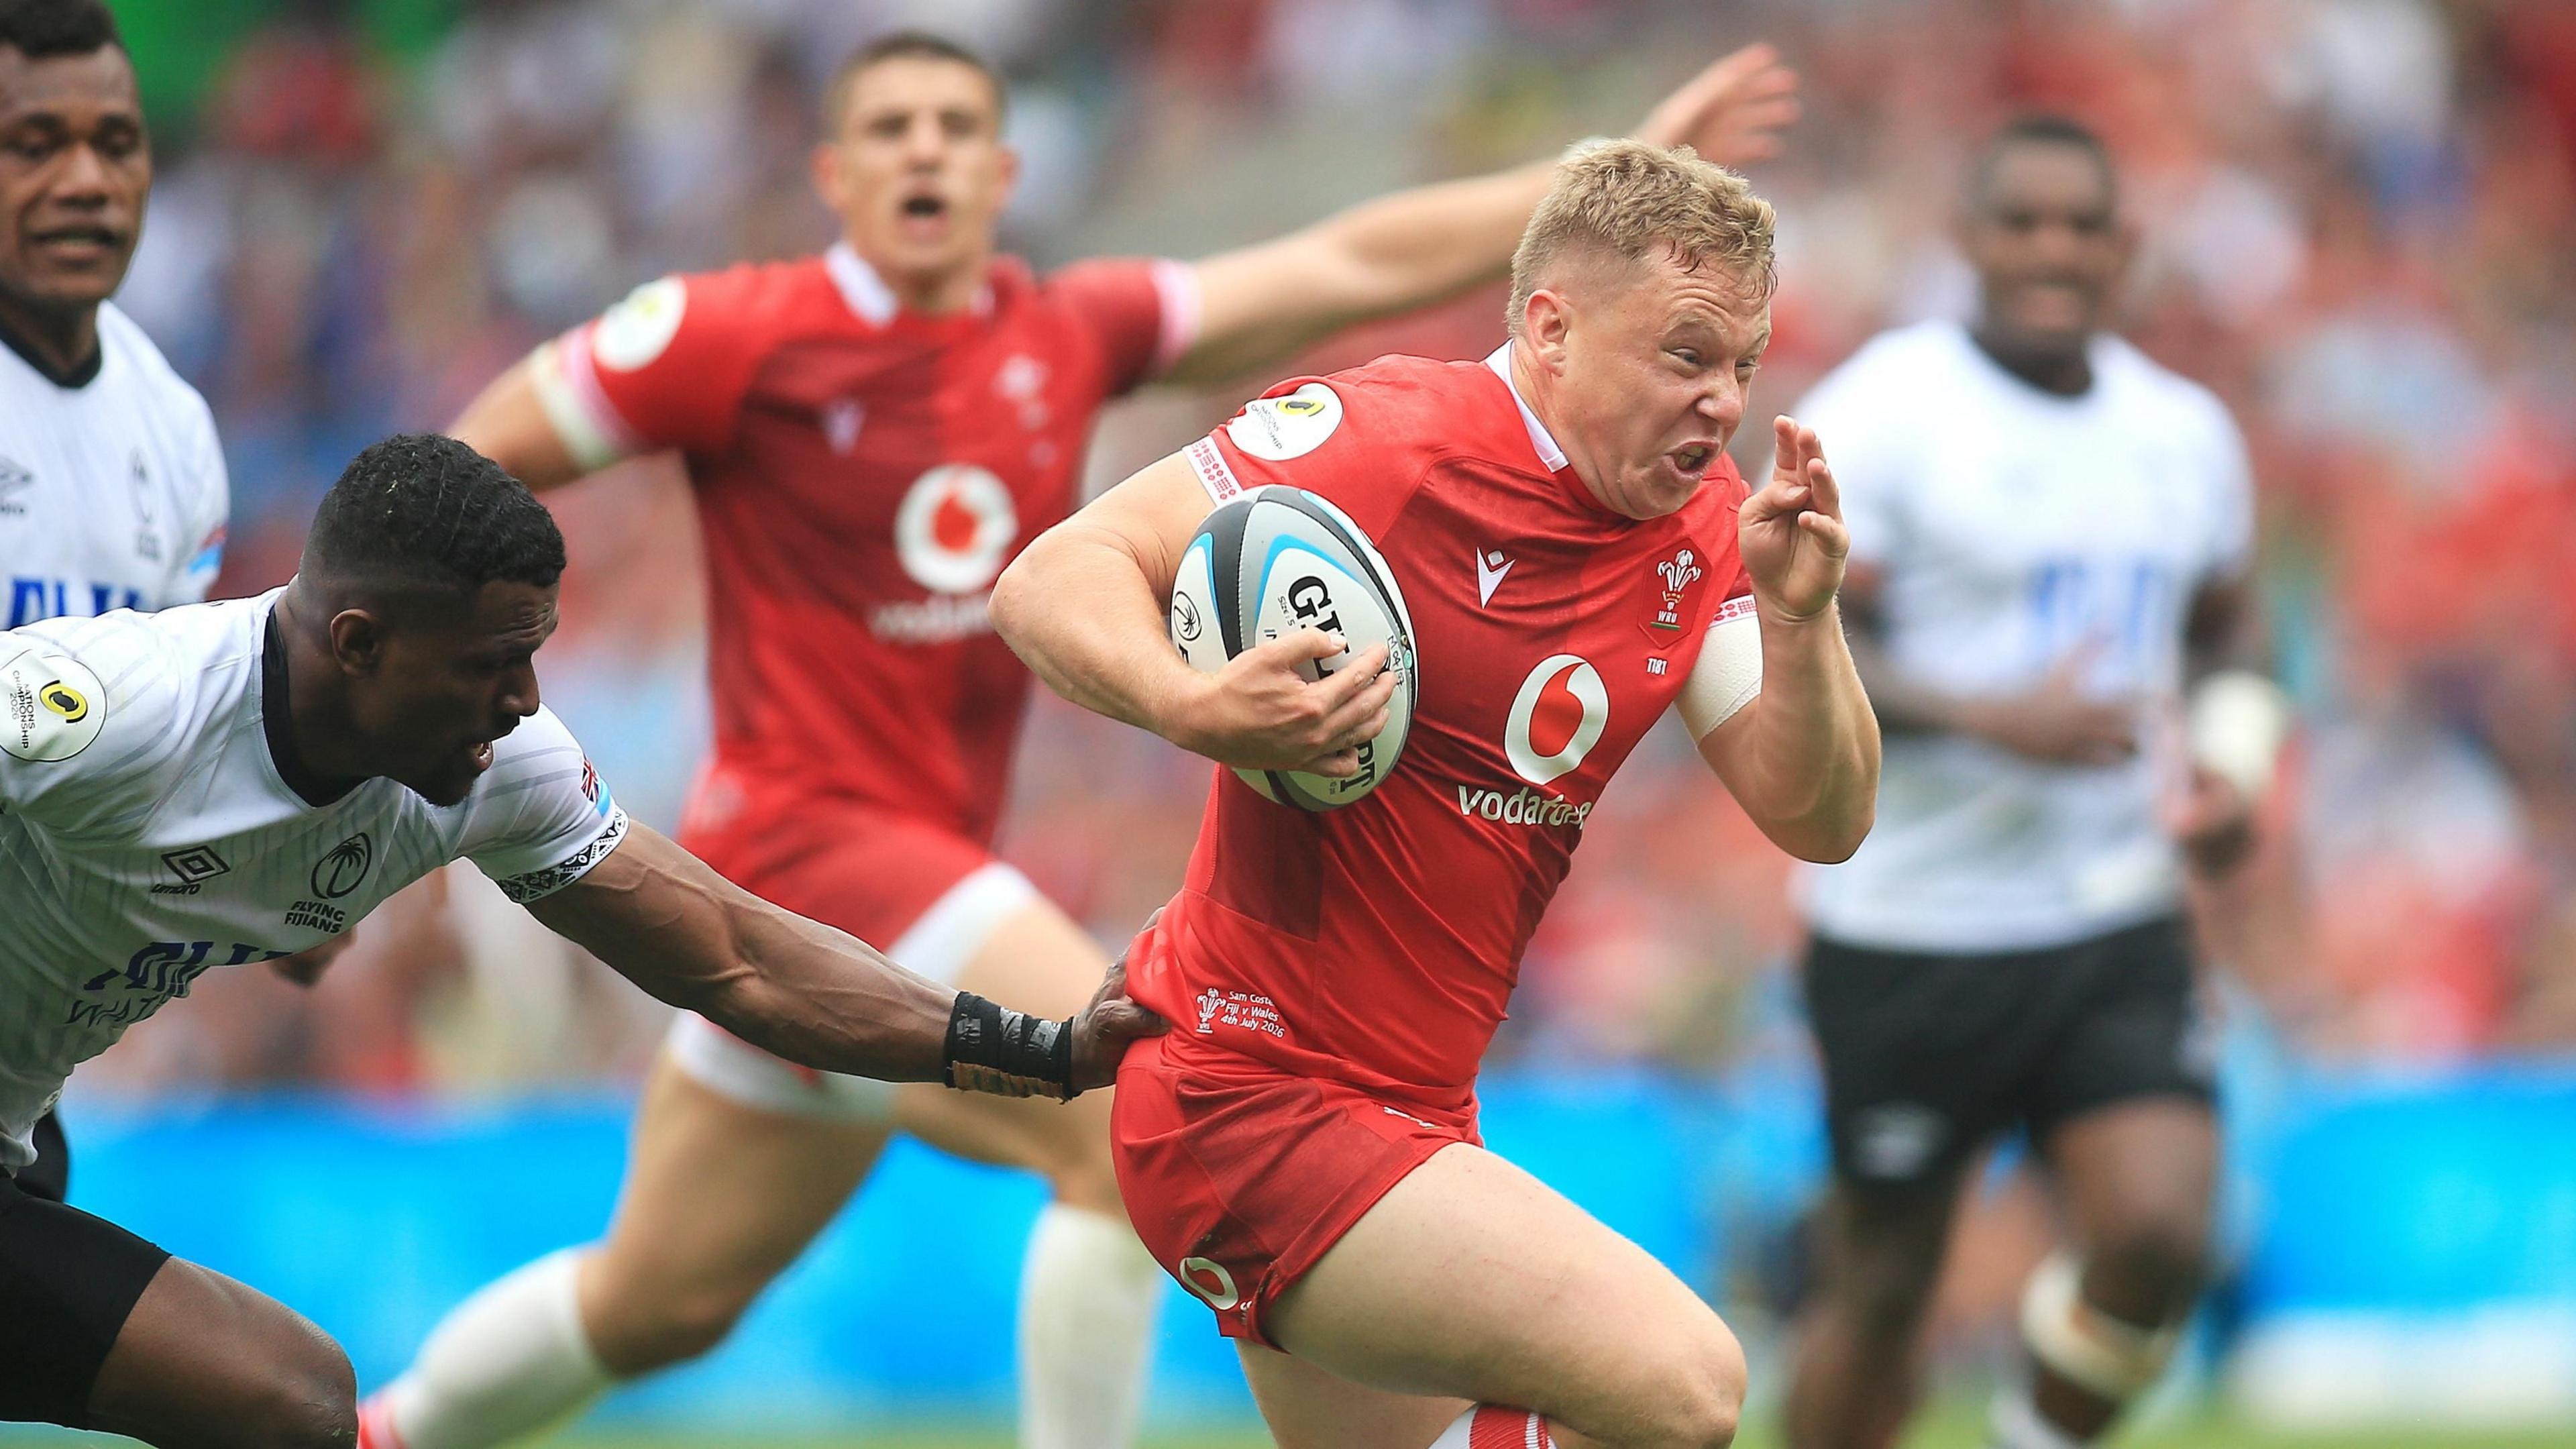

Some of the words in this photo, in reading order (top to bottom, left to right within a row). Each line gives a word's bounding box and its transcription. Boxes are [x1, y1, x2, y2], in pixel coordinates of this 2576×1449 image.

[1658, 610, 1678, 623] WRU
[1647, 657, 1668, 675] 1181
[9, 693, 19, 720] 2026
[23, 684, 36, 729] NATIONS
[150, 883, 201, 896] umbro
[290, 900, 346, 922] FLYING
[284, 912, 343, 934] FIJIANS
[1228, 991, 1248, 1002] Sam
[1250, 994, 1275, 1008] Coste
[1225, 1002, 1240, 1016] Fiji
[1242, 1007, 1248, 1015] v
[1250, 1006, 1279, 1022] Wales
[1220, 1014, 1238, 1025] 4th
[1239, 1017, 1259, 1031] July
[1260, 1020, 1285, 1038] 2026
